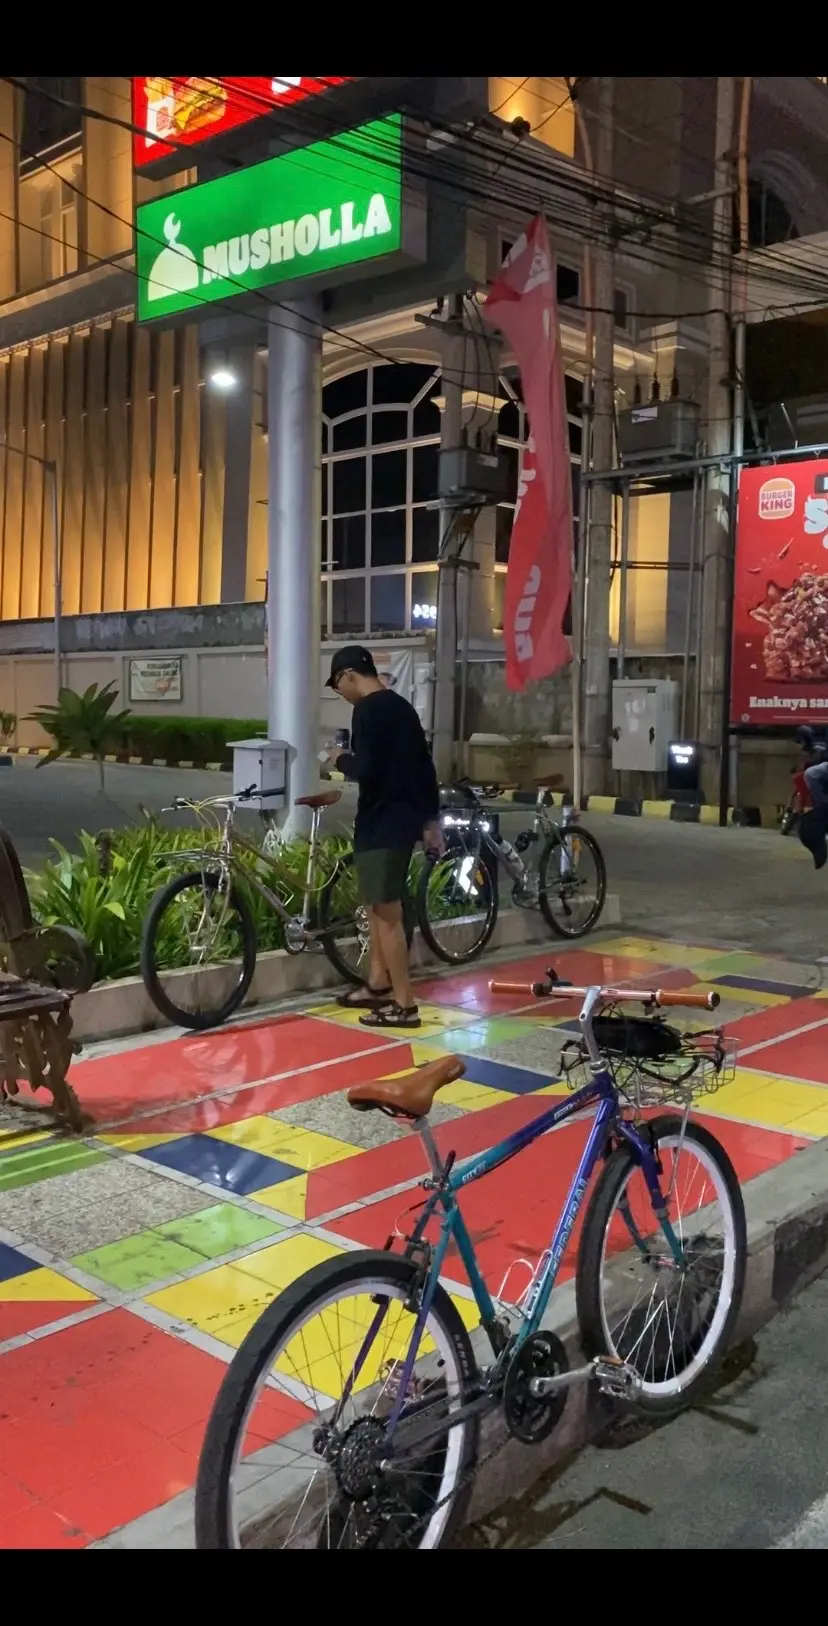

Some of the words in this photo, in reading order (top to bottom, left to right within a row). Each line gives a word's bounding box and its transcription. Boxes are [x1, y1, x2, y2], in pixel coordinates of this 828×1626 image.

[202, 193, 392, 285] MUSHOLLA
[761, 490, 793, 501] BURGER
[761, 499, 793, 512] KING
[749, 696, 808, 711] Enaknya
